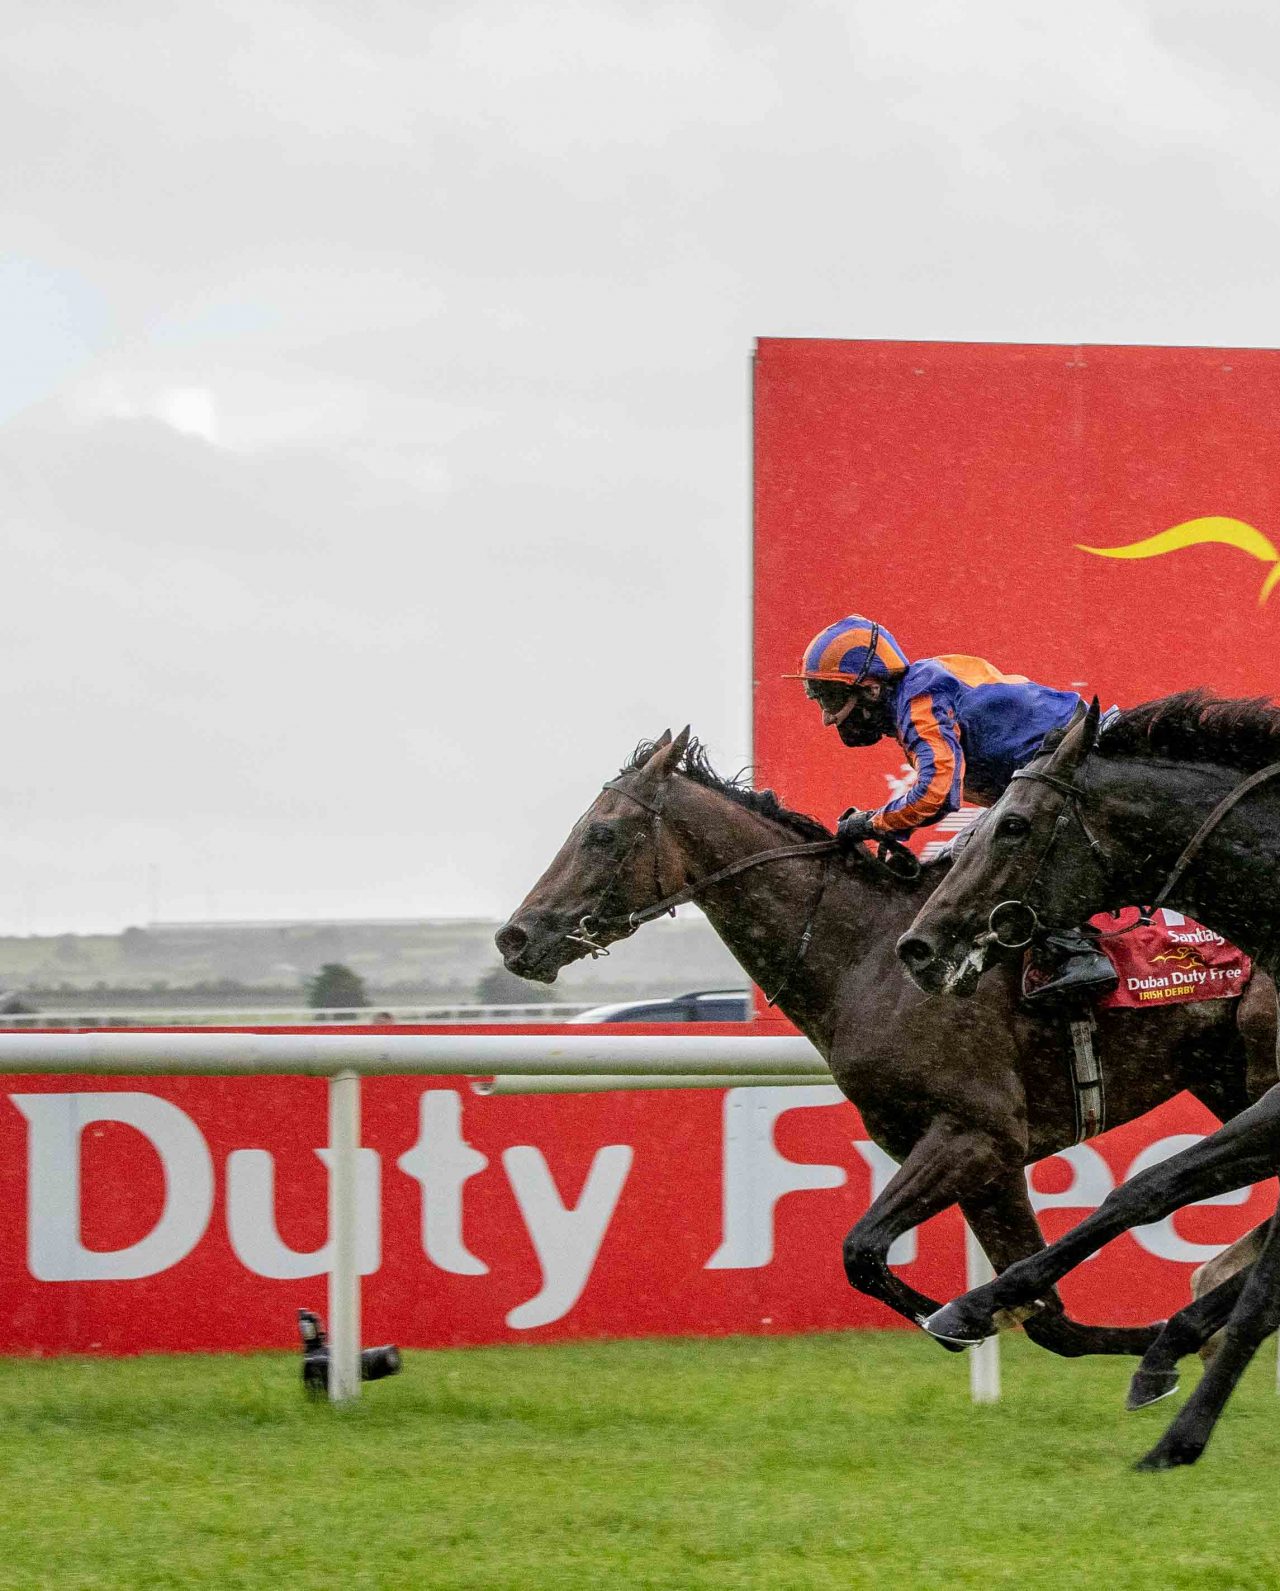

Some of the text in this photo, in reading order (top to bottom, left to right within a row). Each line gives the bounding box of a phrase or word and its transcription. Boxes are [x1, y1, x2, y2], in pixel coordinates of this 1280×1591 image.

[1127, 967, 1242, 991] Dubai Duty Free
[1139, 985, 1196, 1001] IRISH DERBY
[10, 1090, 635, 1330] Duty
